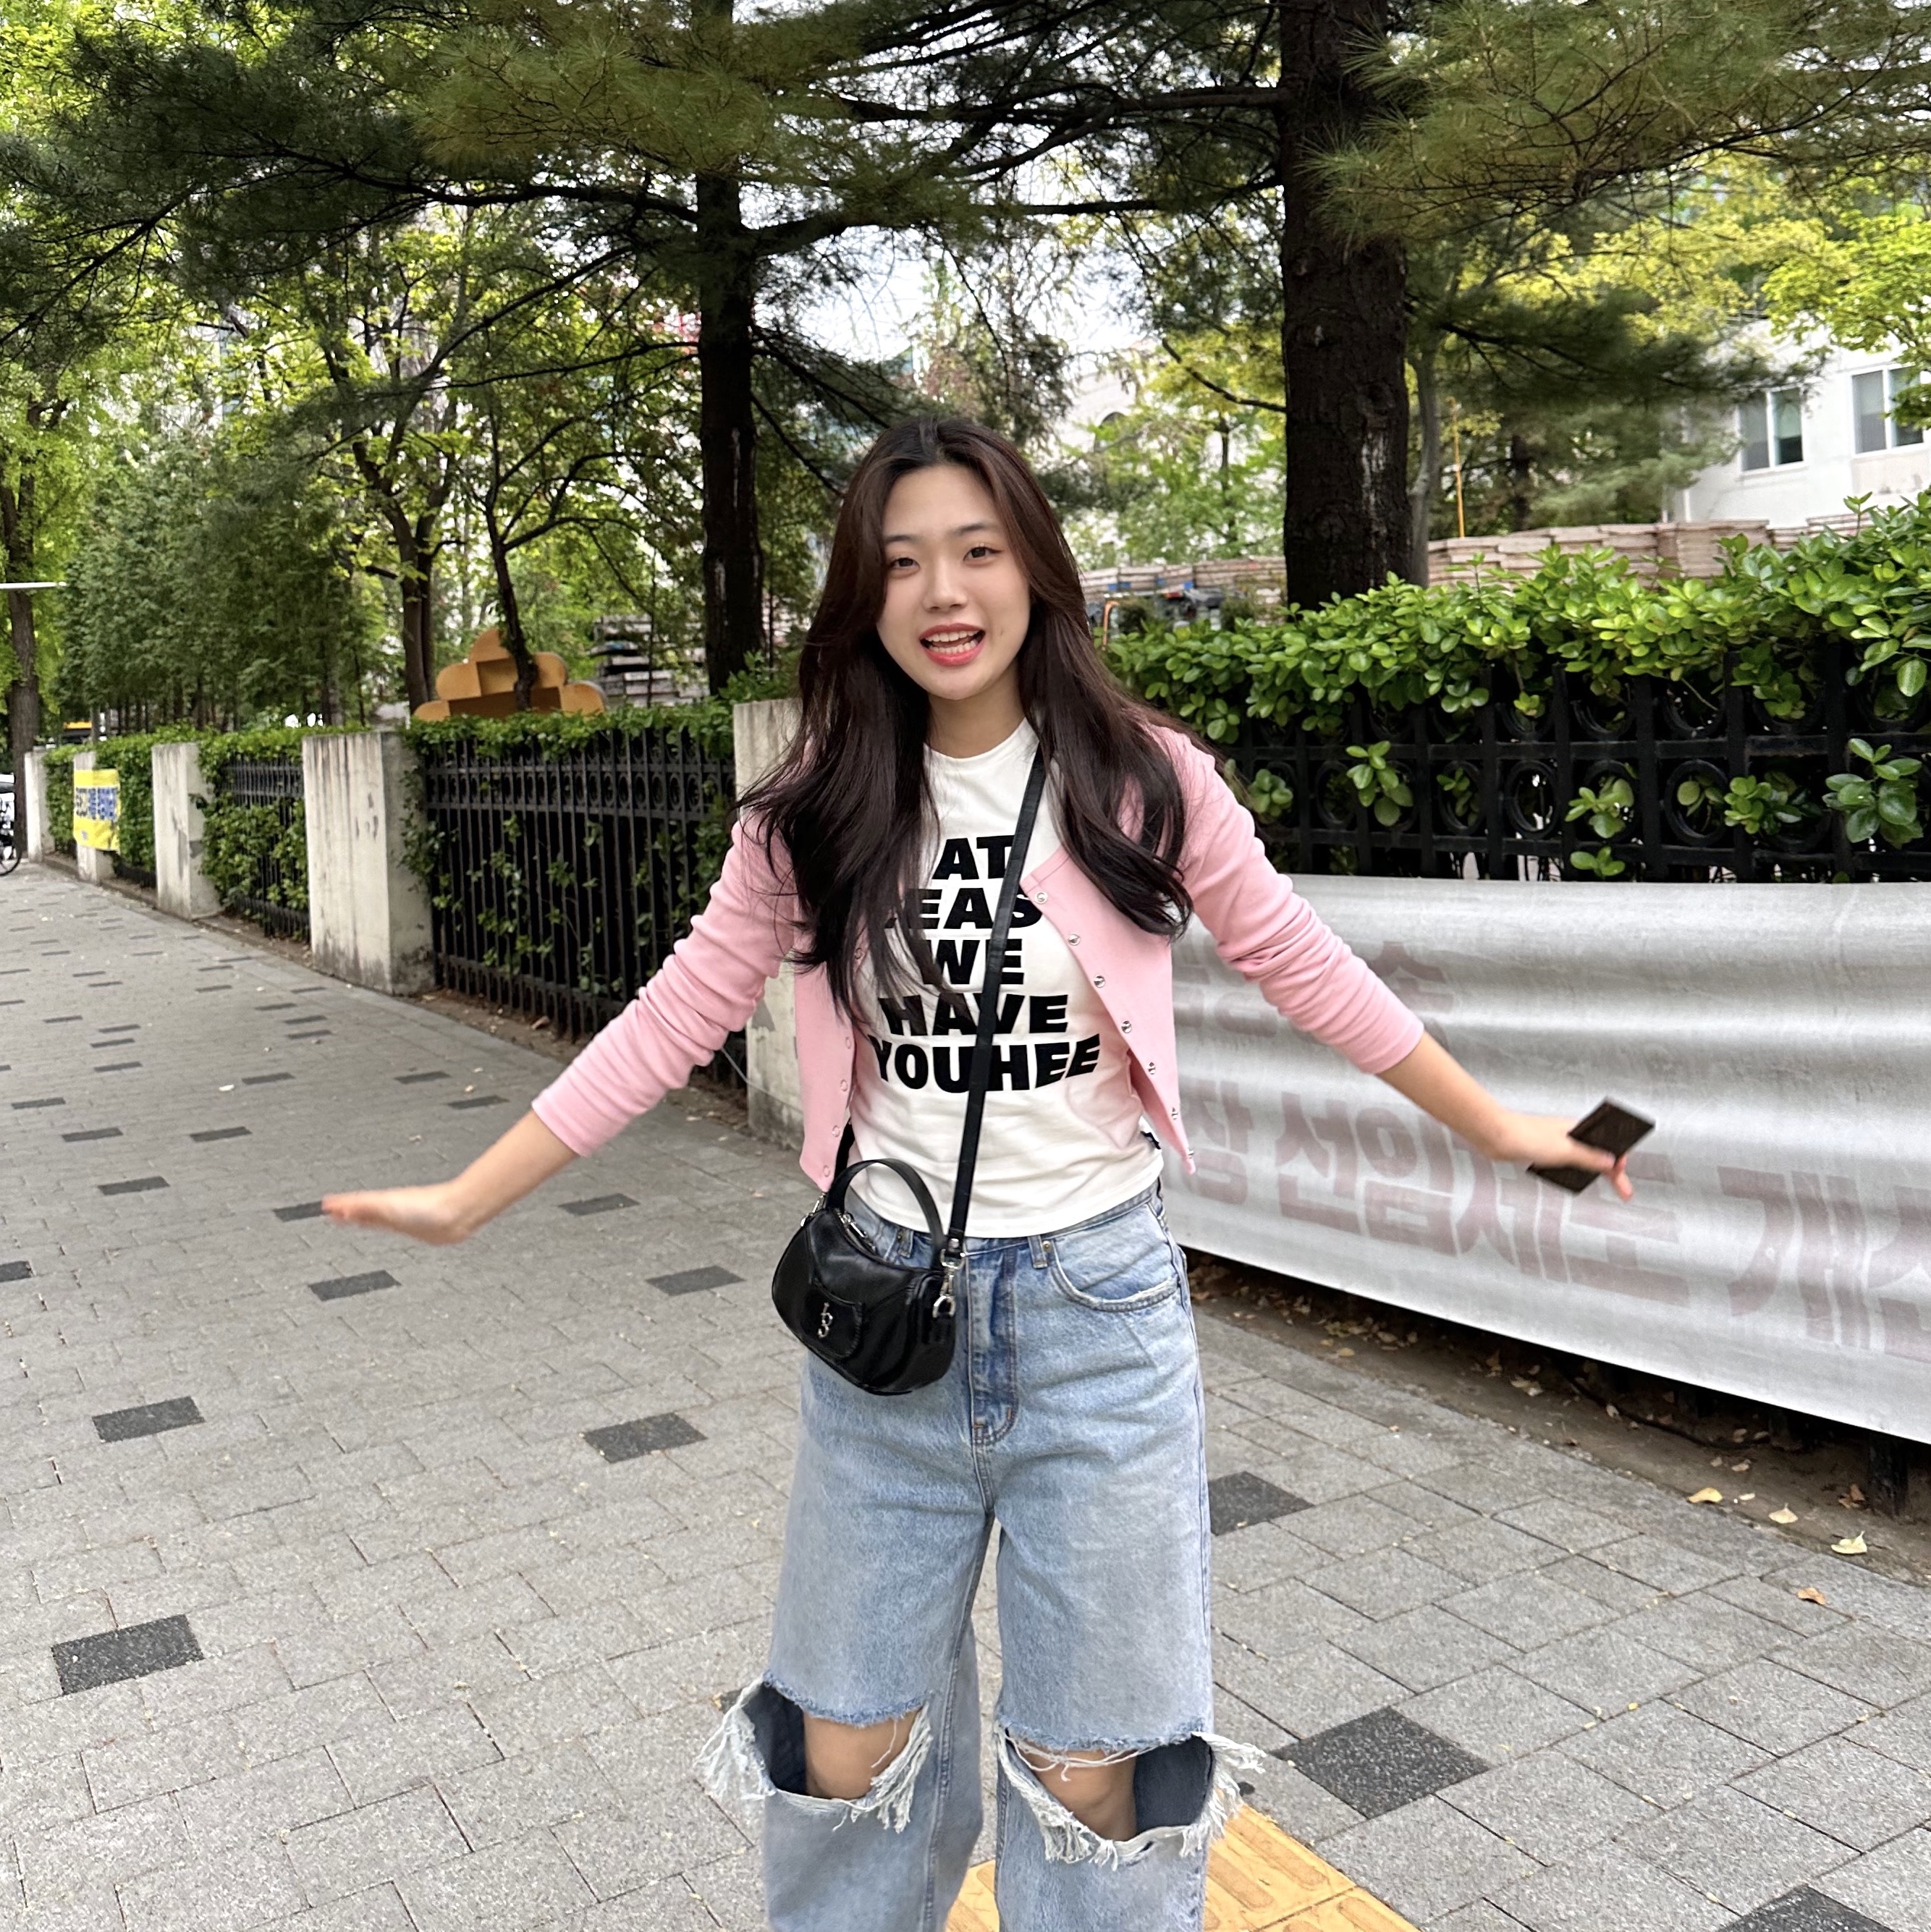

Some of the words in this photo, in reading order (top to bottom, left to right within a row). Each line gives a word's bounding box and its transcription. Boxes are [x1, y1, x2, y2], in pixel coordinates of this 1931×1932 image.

[931, 835, 1016, 880] AT
[884, 886, 1043, 930] EAS
[922, 939, 1024, 984] WE
[878, 993, 1068, 1036] HAVE
